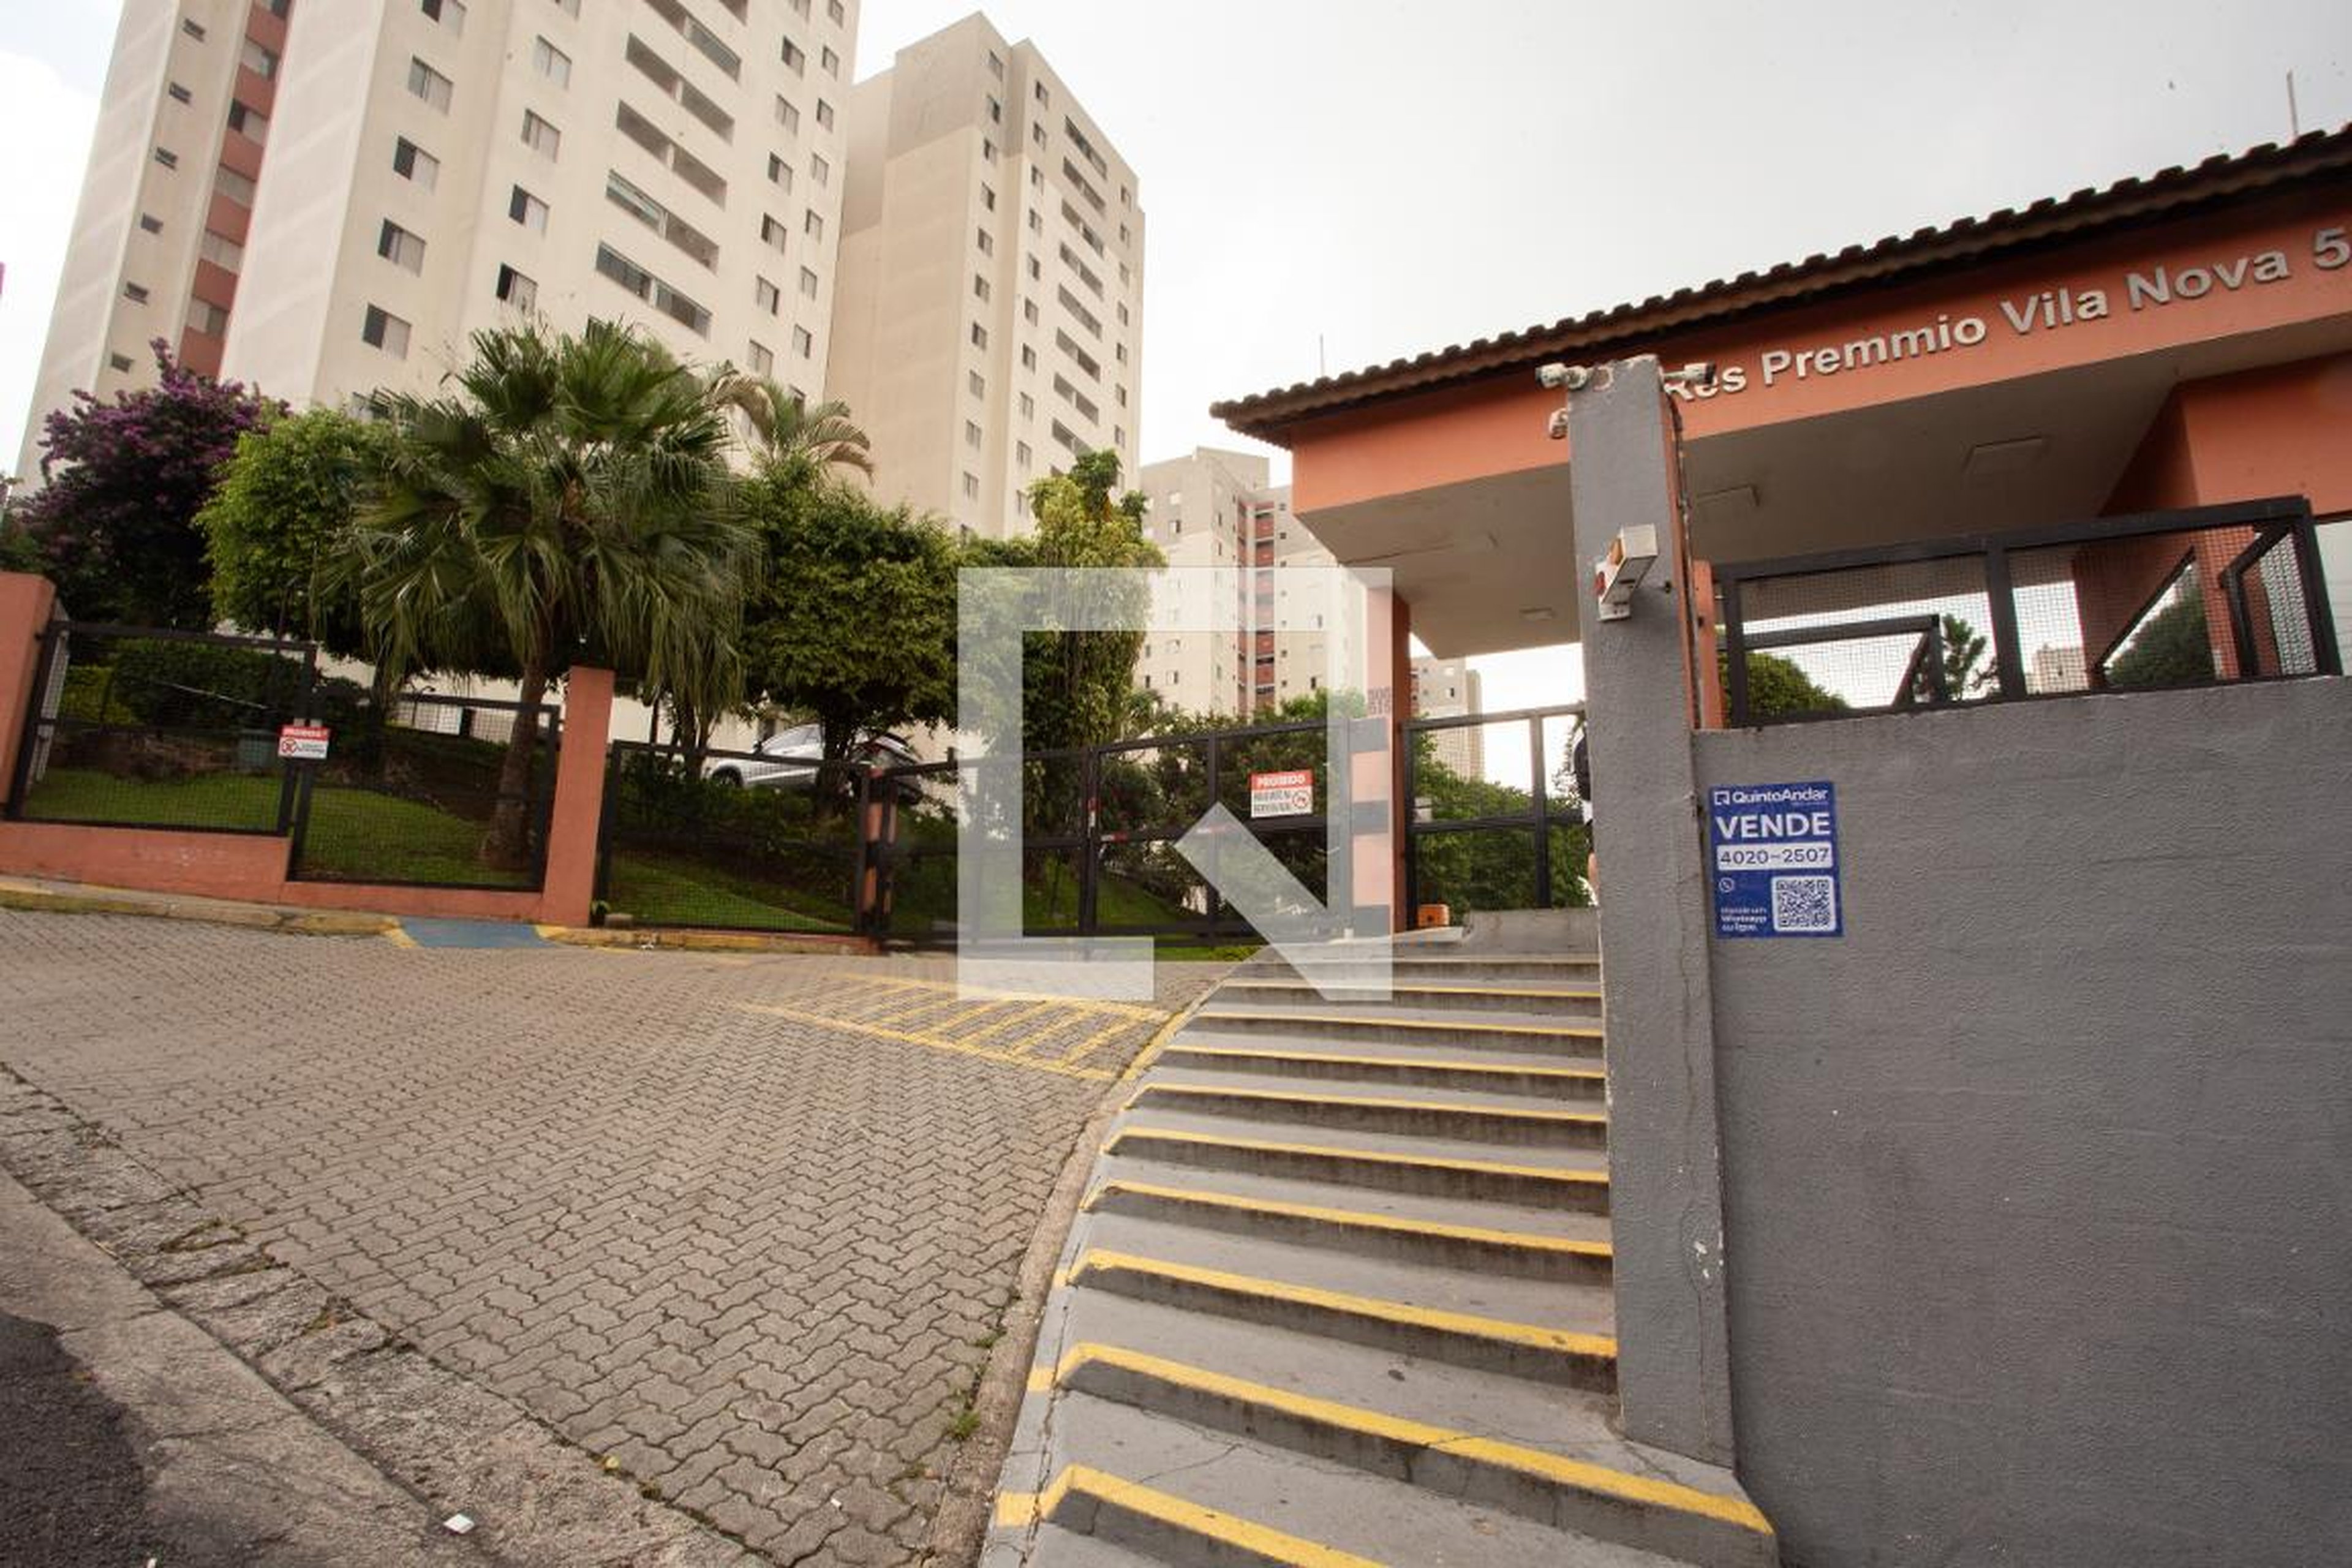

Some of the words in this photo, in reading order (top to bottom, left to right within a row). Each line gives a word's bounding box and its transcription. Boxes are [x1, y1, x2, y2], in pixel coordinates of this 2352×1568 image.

[1762, 316, 1986, 386] Premmio
[2000, 288, 2108, 334] Vila
[2126, 250, 2288, 311] Nova
[2315, 228, 2351, 270] 5
[1733, 788, 1828, 803] QuintoAndar
[1716, 812, 1831, 839] VENDE
[1719, 848, 1830, 864] 4020-2507
